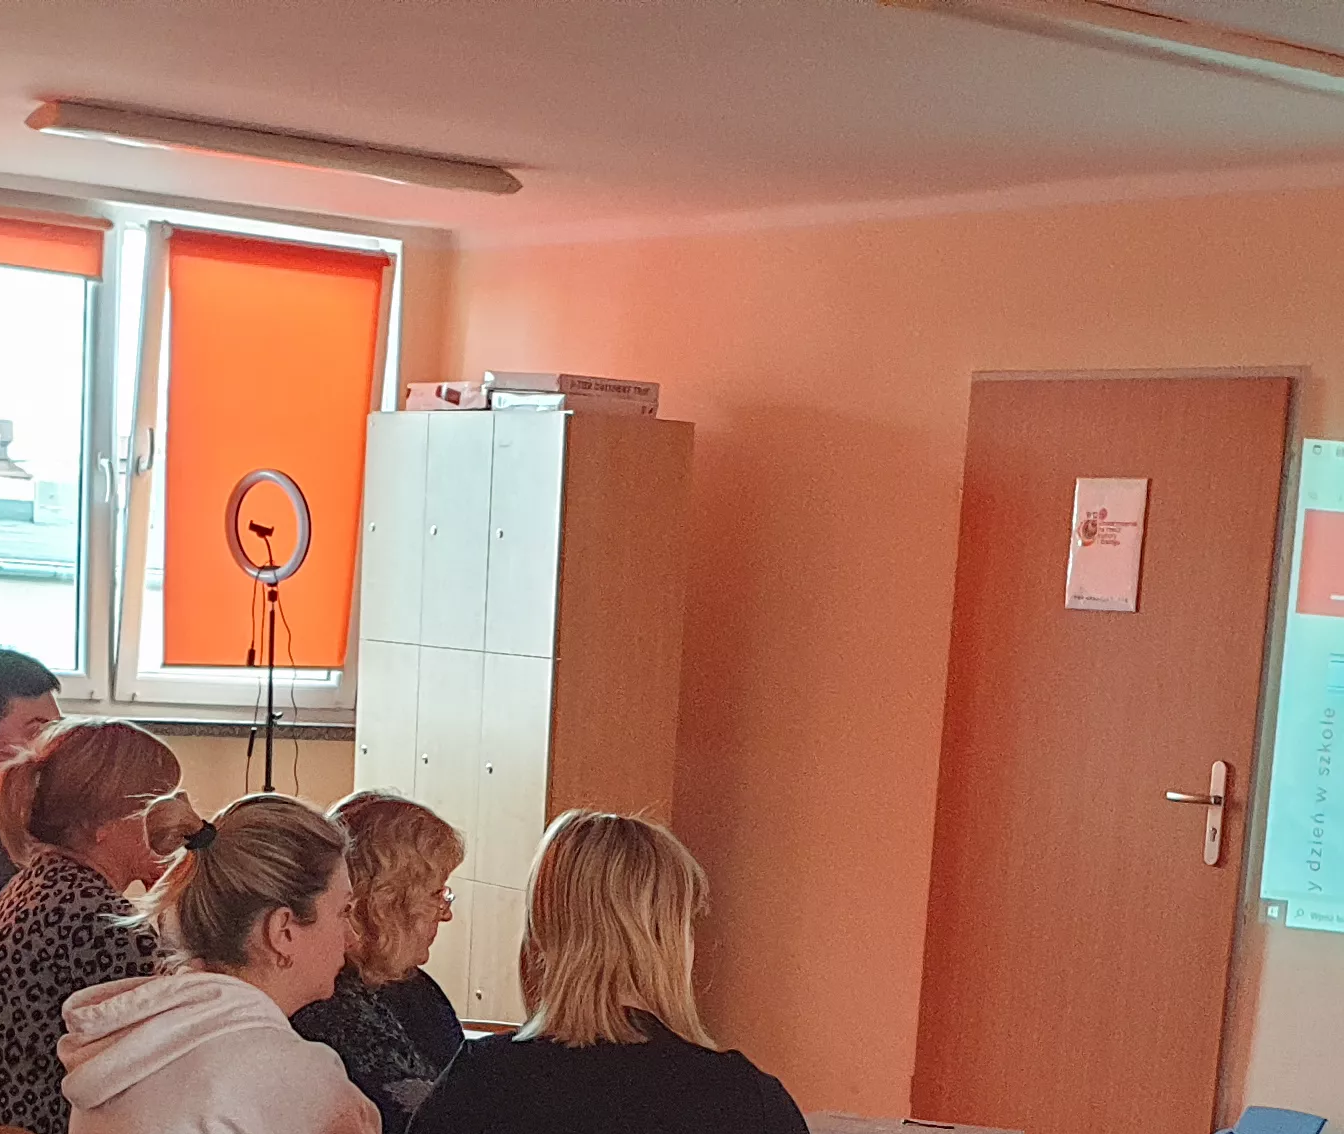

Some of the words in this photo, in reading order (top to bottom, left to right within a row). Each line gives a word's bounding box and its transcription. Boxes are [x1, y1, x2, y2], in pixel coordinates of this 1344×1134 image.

[1317, 707, 1336, 776] szkole
[1315, 786, 1328, 804] w
[1306, 812, 1324, 872] dzień
